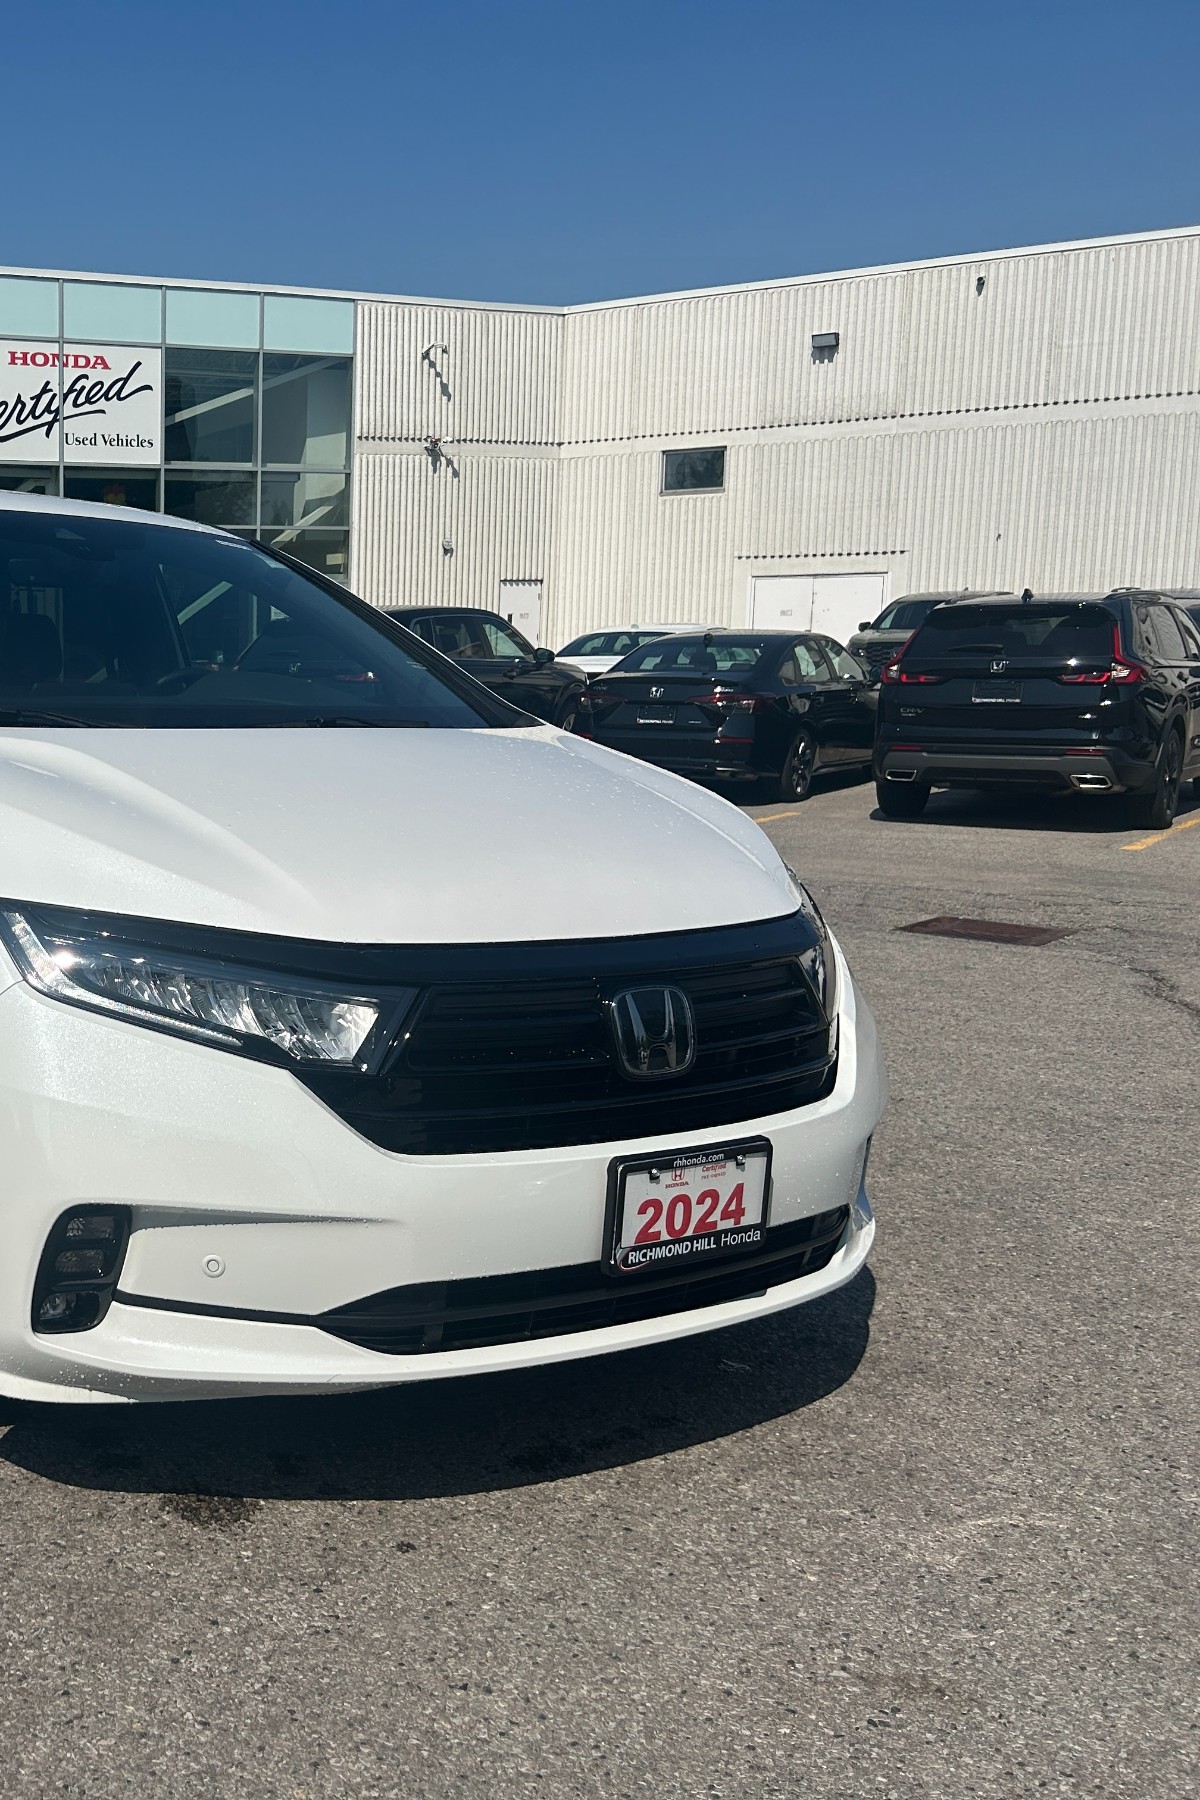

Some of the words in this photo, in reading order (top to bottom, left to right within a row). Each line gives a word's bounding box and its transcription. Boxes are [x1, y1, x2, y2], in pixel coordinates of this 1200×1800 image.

[8, 351, 111, 370] HONDA
[65, 433, 97, 446] Used
[101, 433, 153, 448] Vehicles
[673, 1153, 725, 1168] rhhonda.com
[665, 1181, 689, 1189] HONDA
[634, 1183, 746, 1245] 2024
[628, 1242, 691, 1264] RICHMOND
[693, 1237, 717, 1251] HILL
[721, 1229, 761, 1247] Honda
